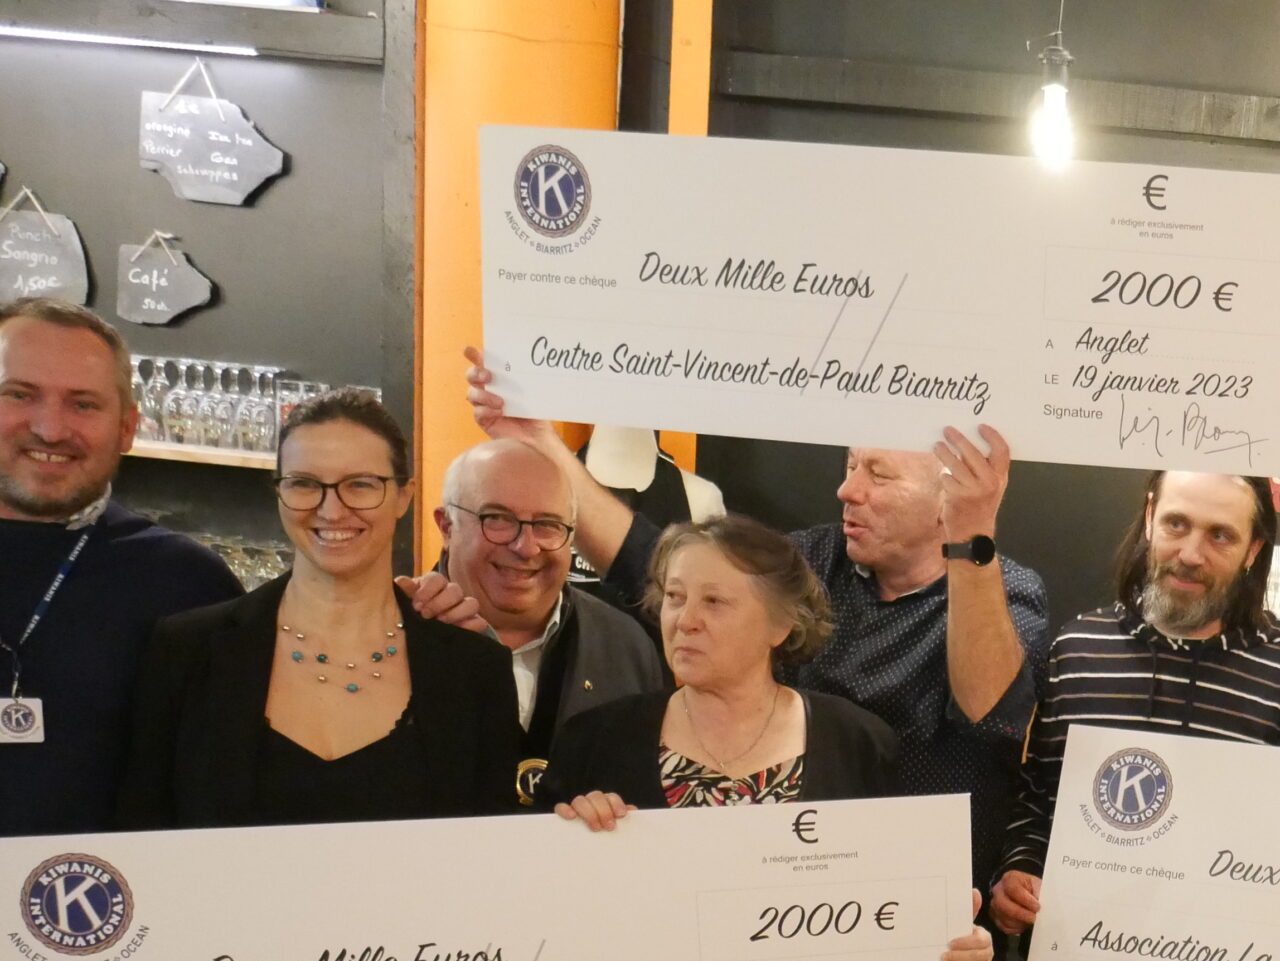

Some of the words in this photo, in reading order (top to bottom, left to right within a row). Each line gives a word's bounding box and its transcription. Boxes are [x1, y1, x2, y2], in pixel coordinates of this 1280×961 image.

[528, 153, 577, 175] KIWANIS
[520, 182, 584, 230] INTERNATIONAL
[537, 164, 570, 216] K
[1142, 174, 1169, 211] €
[504, 210, 530, 243] ANGLET
[536, 242, 574, 255] BIARRITZ
[579, 217, 602, 245] OCEAN
[128, 267, 168, 292] Café
[498, 269, 527, 281] Payer
[530, 273, 561, 283] contre
[564, 276, 576, 284] ce
[638, 251, 708, 287] Deux
[715, 258, 785, 293] Mille
[793, 263, 874, 298] Euros
[1091, 270, 1202, 309] 2000
[1212, 282, 1239, 312] €
[1045, 339, 1054, 349] A
[1076, 326, 1149, 364] Anglet
[531, 335, 602, 372] Centre
[609, 342, 881, 395] Saint-Vincent-de-Paul
[887, 364, 990, 415] Biarritz
[1044, 374, 1059, 385] LE
[1073, 365, 1097, 388] 19
[1092, 370, 1180, 401] janvier
[1185, 373, 1253, 398] 2023
[1043, 404, 1103, 420] Signature
[1111, 755, 1161, 776] KIWANIS
[1100, 779, 1165, 824] INTERNATIONAL
[1114, 765, 1151, 810] K
[792, 809, 818, 844] €
[1080, 803, 1101, 834] ANGLET
[1106, 834, 1145, 847] BIARRITZ
[1152, 814, 1179, 840] OCEAN
[38, 862, 112, 886] KIWANIS
[801, 850, 859, 862] exclusivement
[1062, 856, 1092, 869] Payer
[1095, 861, 1127, 873] contre
[1130, 865, 1143, 875] ce
[1208, 849, 1280, 885] Deux
[30, 894, 124, 947] INTERNATIONAL
[55, 875, 102, 934] K
[750, 901, 862, 942] 2000
[874, 901, 899, 931] €
[120, 925, 150, 959] OCEAN
